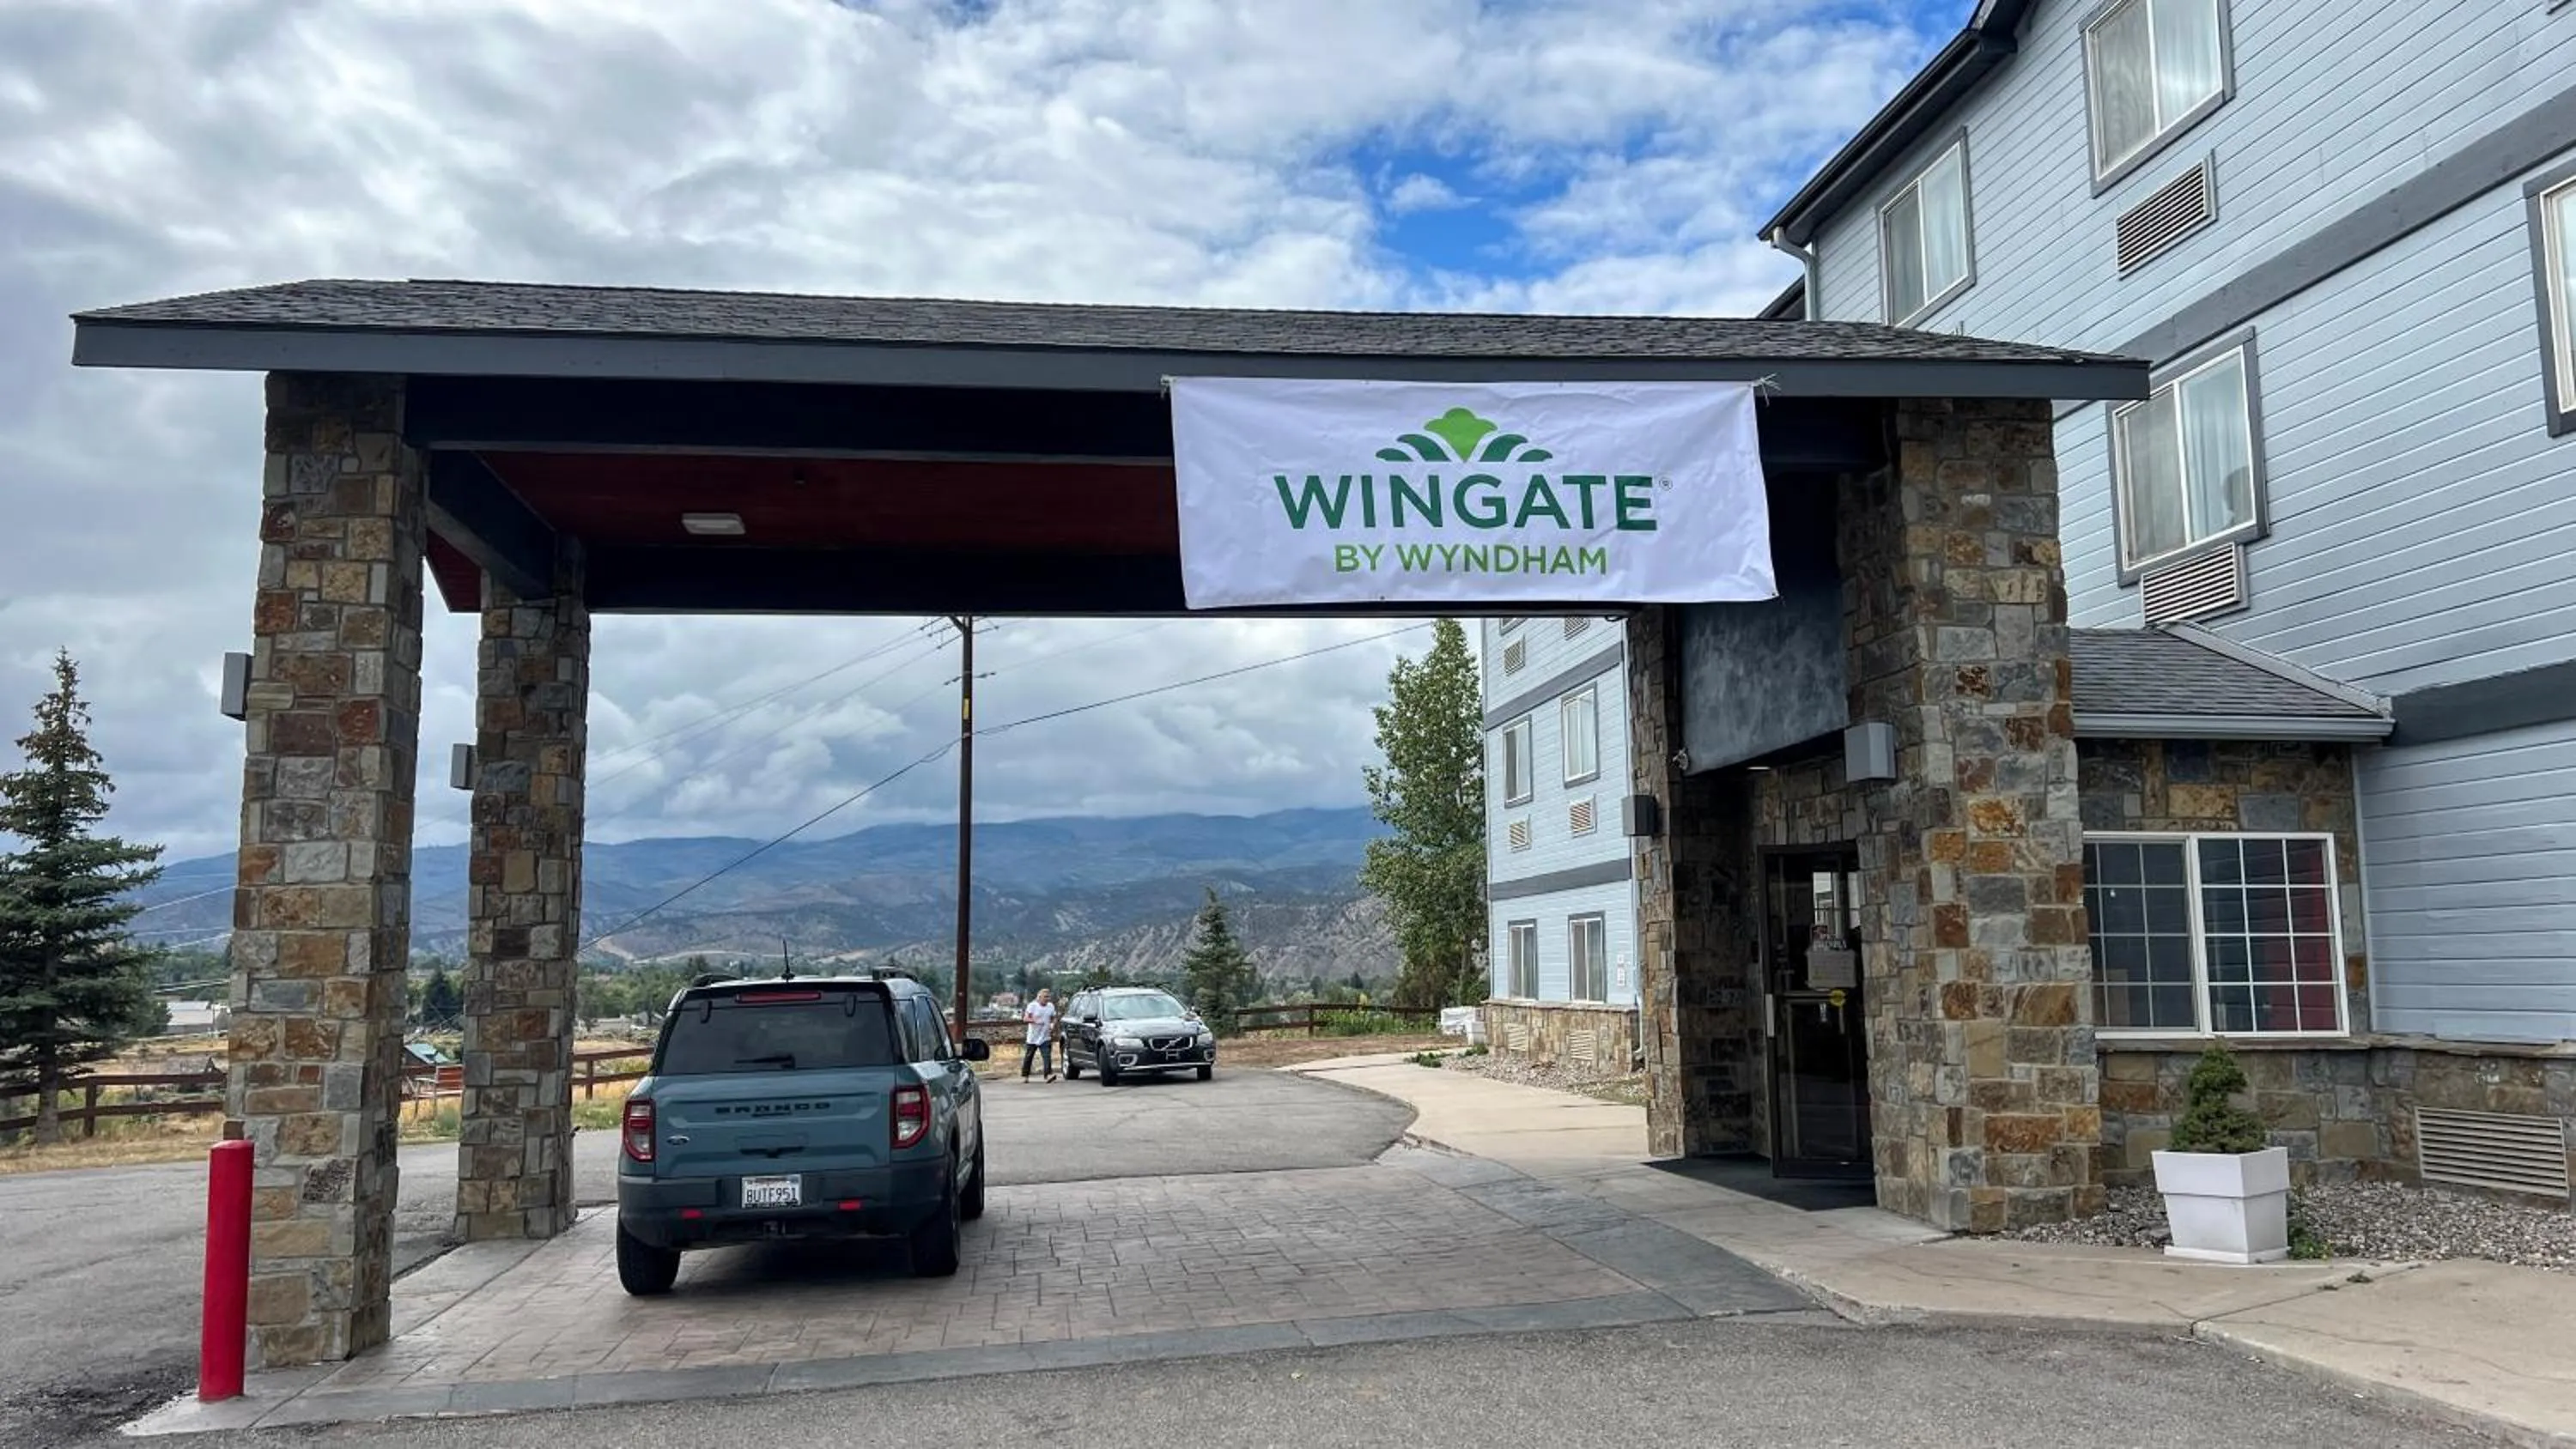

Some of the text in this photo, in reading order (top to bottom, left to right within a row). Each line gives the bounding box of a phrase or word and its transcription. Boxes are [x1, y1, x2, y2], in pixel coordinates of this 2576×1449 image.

[1273, 475, 1657, 530] WINGATE
[1335, 543, 1607, 574] BY WYNDHAM
